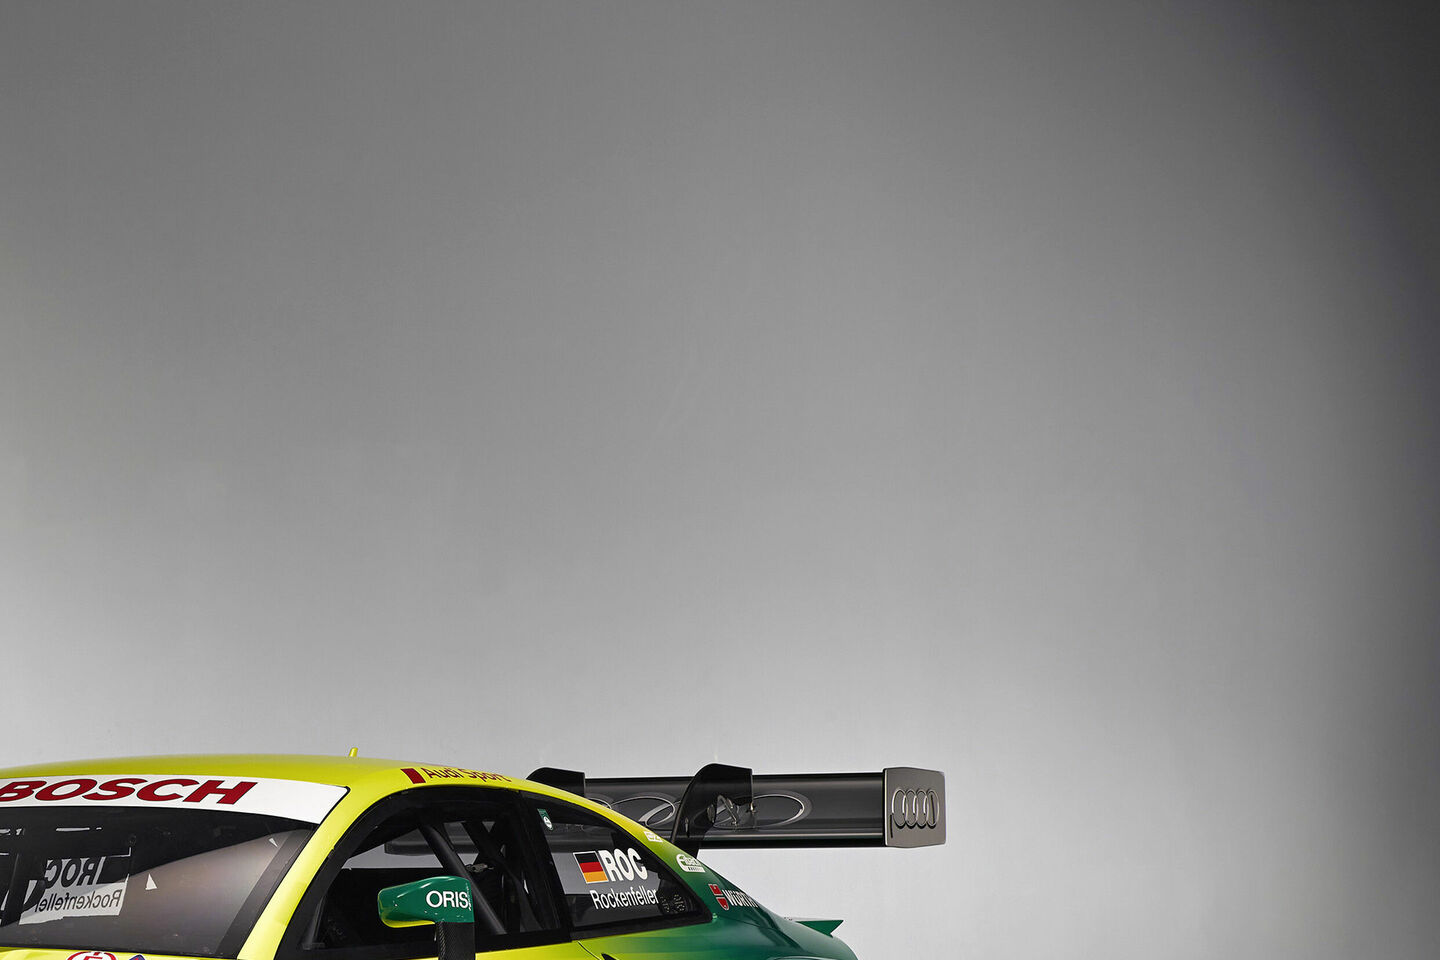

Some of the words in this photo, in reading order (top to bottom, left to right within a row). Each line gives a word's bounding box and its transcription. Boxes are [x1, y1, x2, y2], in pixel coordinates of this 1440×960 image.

[421, 767, 465, 779] Audi
[602, 848, 648, 882] ROC
[426, 890, 469, 908] ORIS
[590, 885, 659, 911] Rockenfeller
